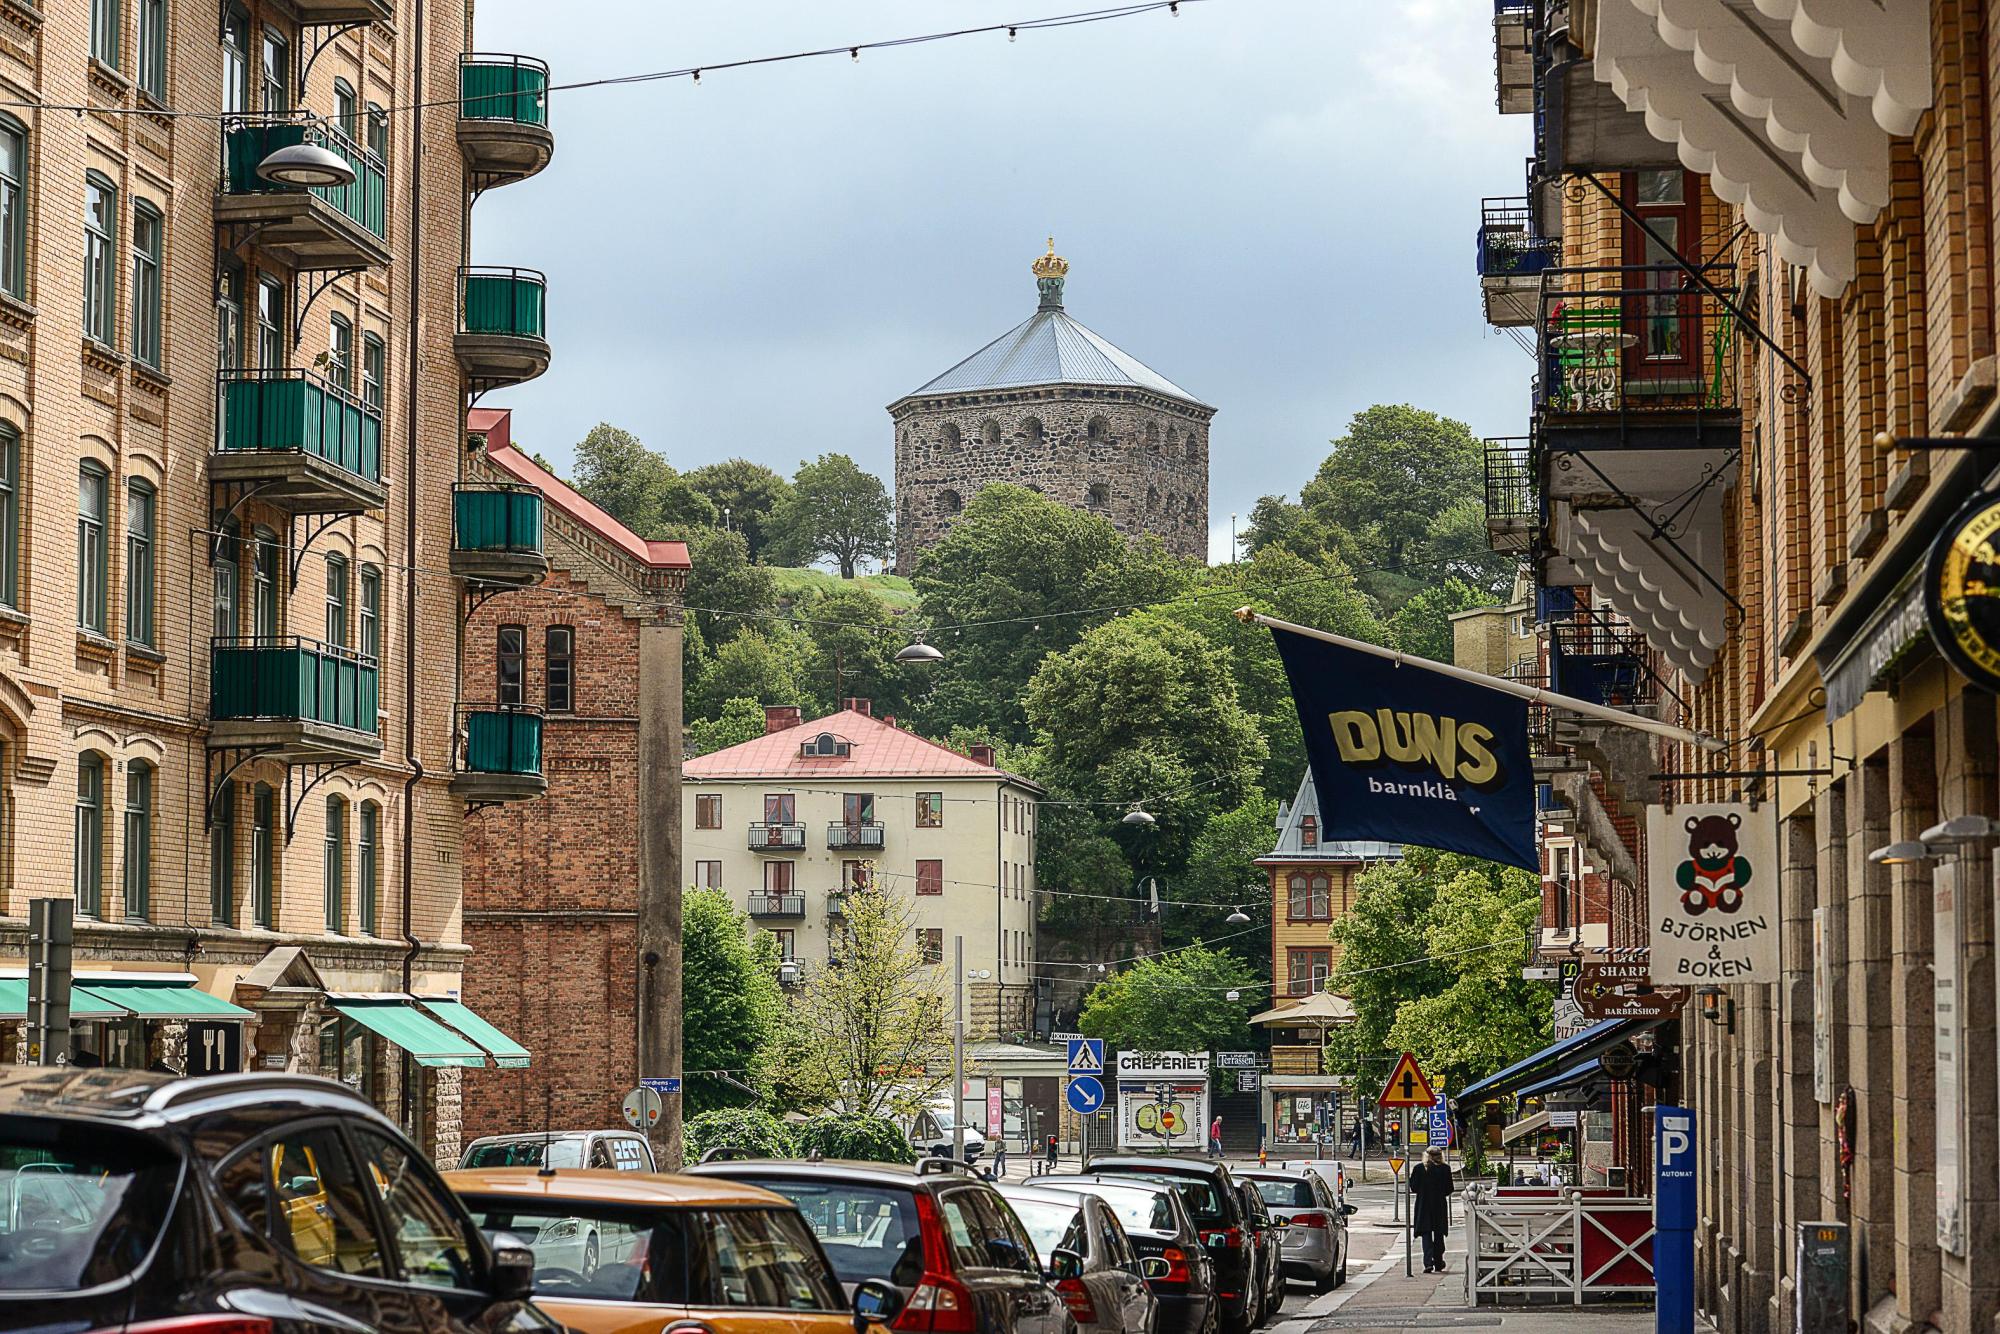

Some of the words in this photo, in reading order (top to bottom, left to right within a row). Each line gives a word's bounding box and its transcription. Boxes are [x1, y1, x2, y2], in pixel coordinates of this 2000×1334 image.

[1328, 708, 1497, 784] DUNS
[1660, 915, 1767, 942] BJÖRNEN
[1708, 944, 1721, 960] &
[1677, 956, 1753, 978] BOKEN
[1219, 1054, 1254, 1066] Terrassen
[1662, 1130, 1689, 1166] P
